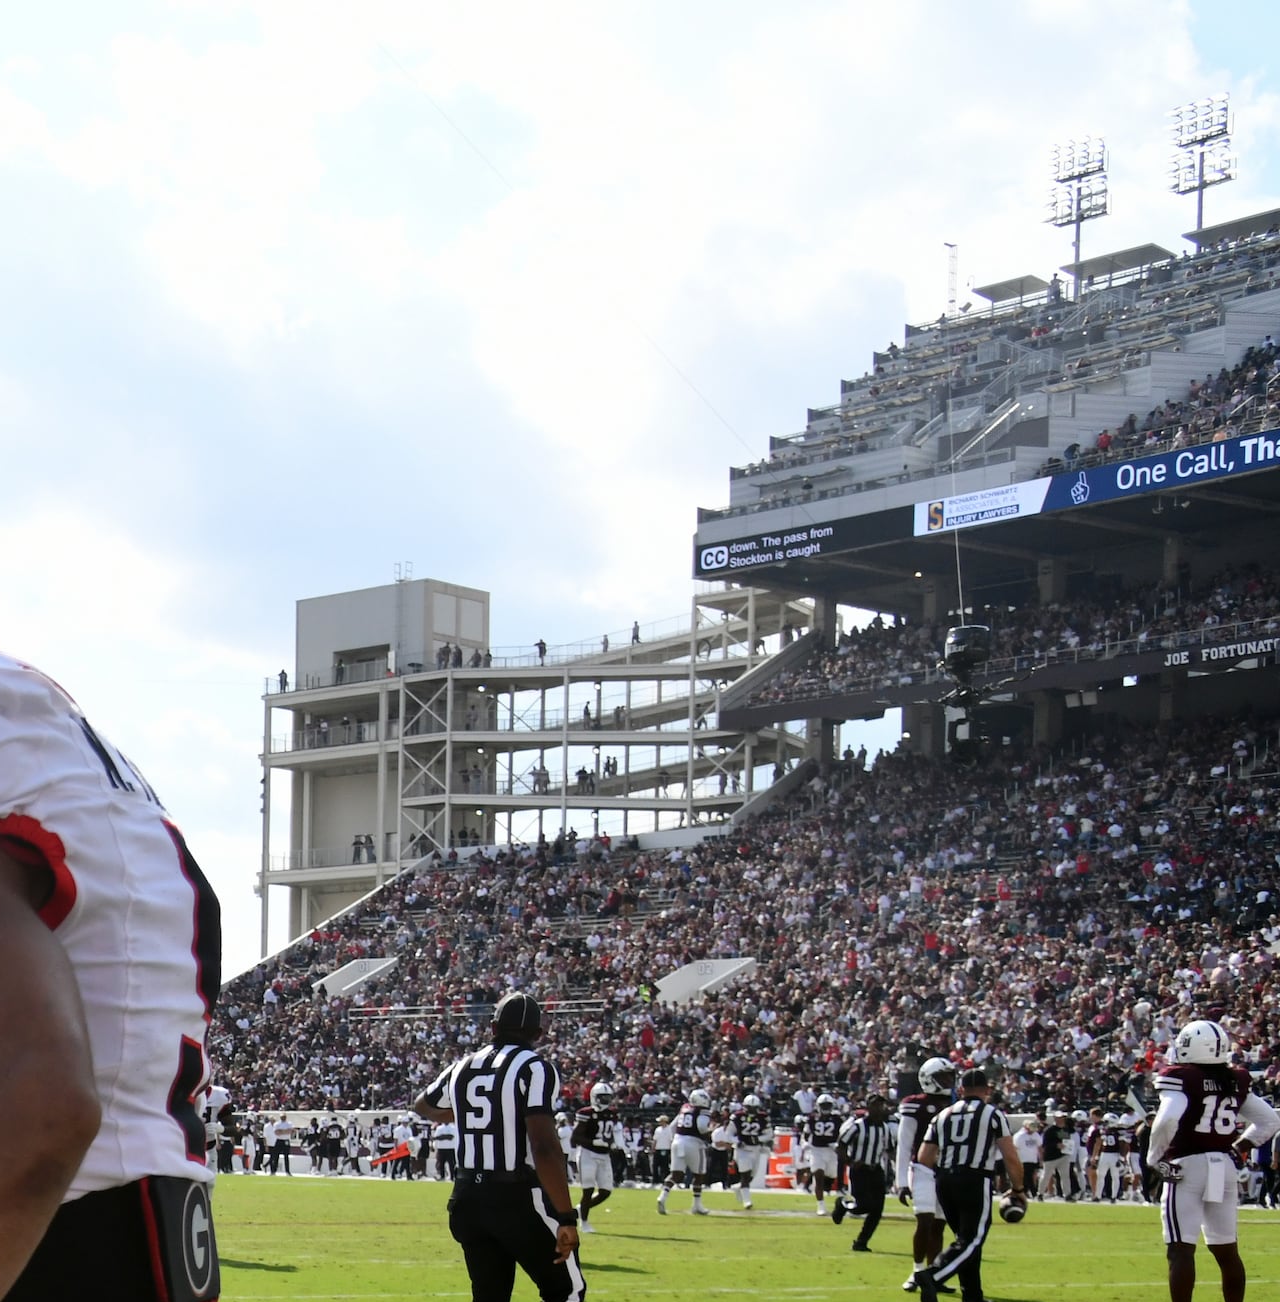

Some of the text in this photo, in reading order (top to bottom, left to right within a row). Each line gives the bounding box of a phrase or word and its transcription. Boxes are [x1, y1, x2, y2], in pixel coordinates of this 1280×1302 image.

[1116, 463, 1166, 490] One
[1175, 444, 1235, 478] Call,
[929, 502, 943, 530] S
[948, 505, 1018, 526] INJURY LAWYERS
[729, 526, 833, 554] down. The pass from
[704, 550, 725, 567] CC
[729, 543, 821, 568] Stockton is caught
[1164, 651, 1189, 666] JOE
[466, 1074, 495, 1129] S
[1194, 1095, 1238, 1135] 16
[741, 1122, 760, 1135] 22
[814, 1122, 834, 1136] 92
[950, 1113, 974, 1142] U
[183, 1183, 212, 1296] G
